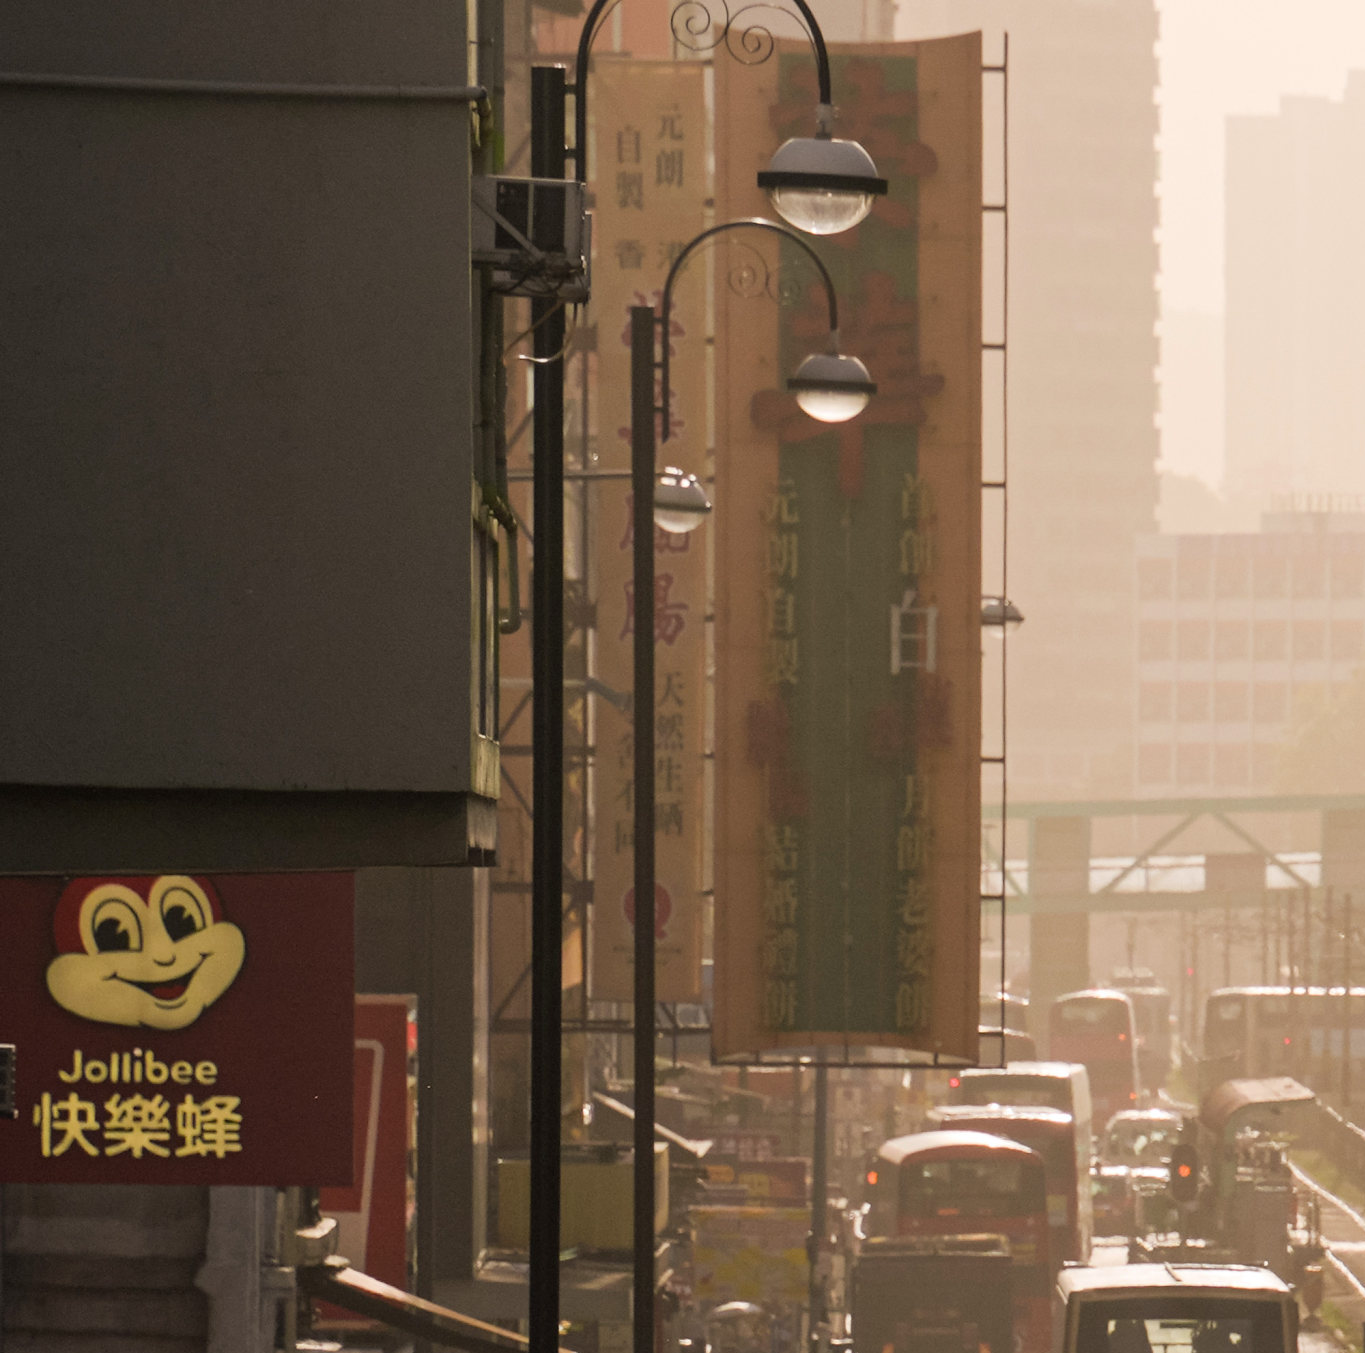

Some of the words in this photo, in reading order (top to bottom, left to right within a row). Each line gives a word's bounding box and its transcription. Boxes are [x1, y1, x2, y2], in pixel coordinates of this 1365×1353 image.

[59, 1048, 218, 1086] Jollibee
[33, 1093, 243, 1159] 快樂蜂
